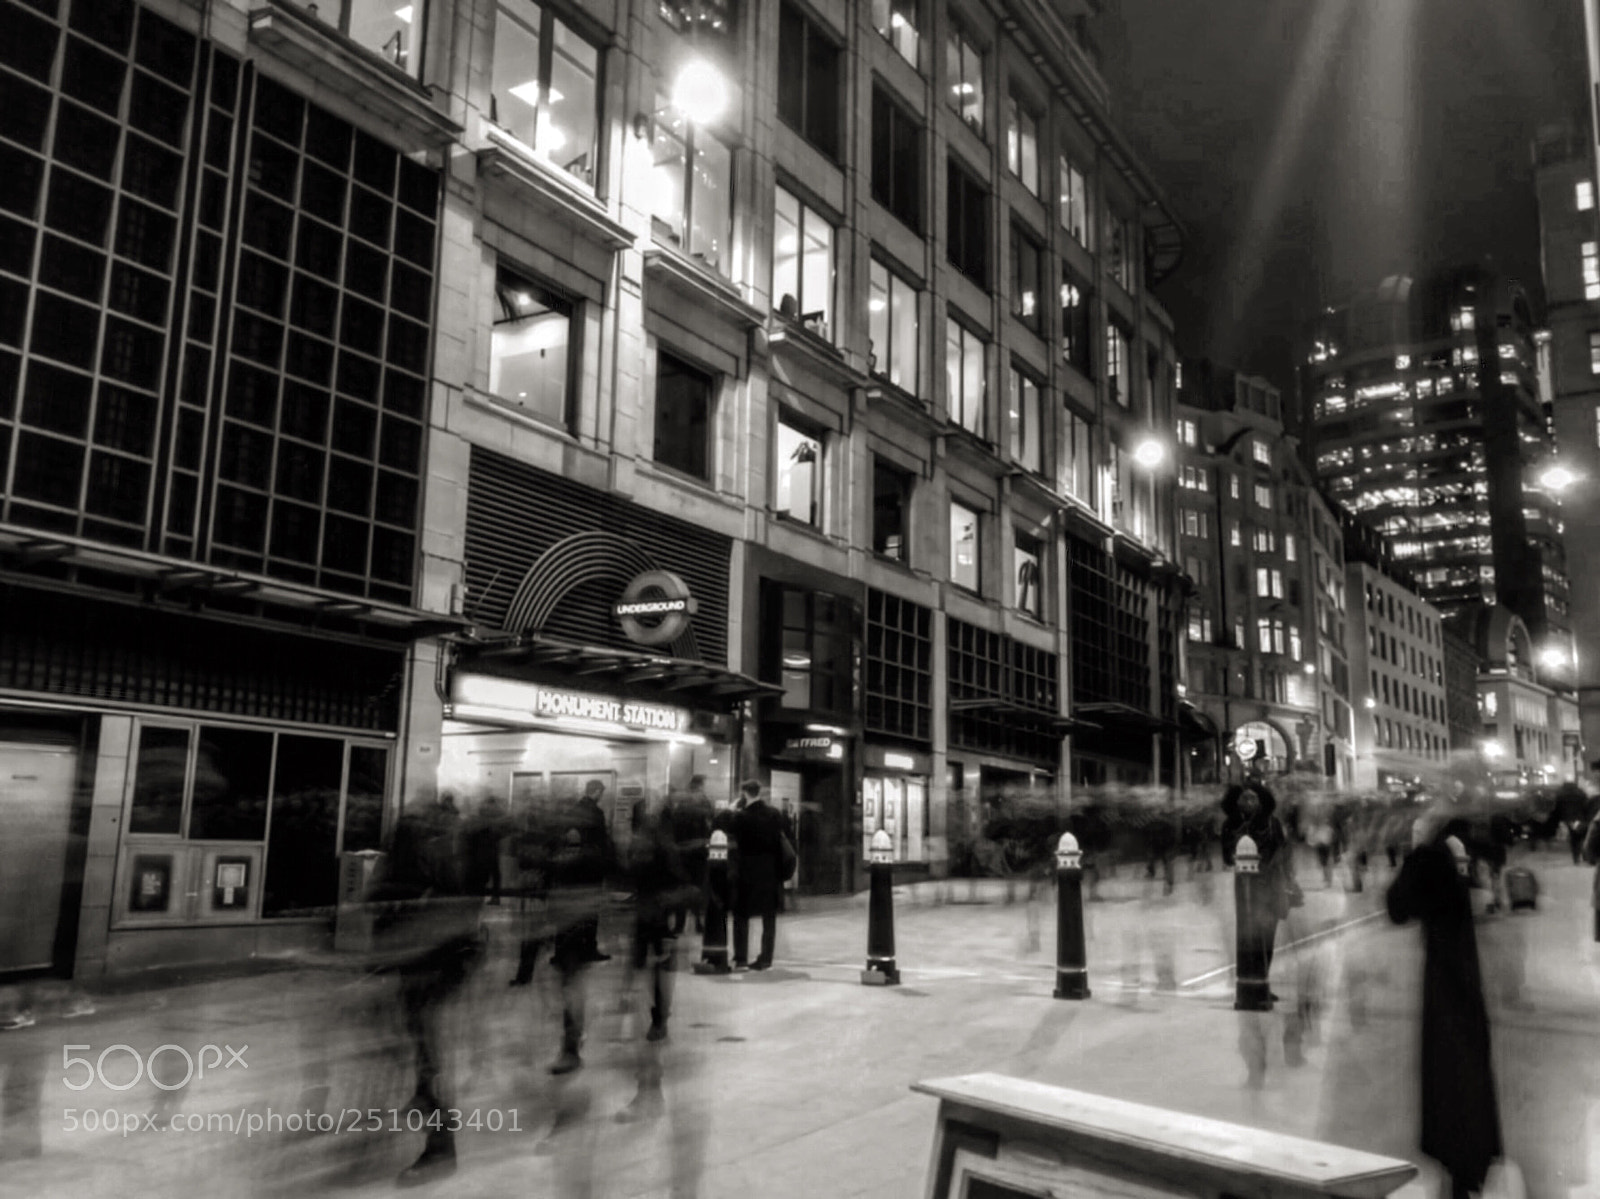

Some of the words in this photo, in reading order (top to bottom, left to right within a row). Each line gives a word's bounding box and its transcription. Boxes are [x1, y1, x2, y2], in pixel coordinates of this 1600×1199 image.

[617, 600, 685, 615] UNDERGROUND
[537, 690, 621, 722] MONUMENT
[623, 704, 676, 729] STATION
